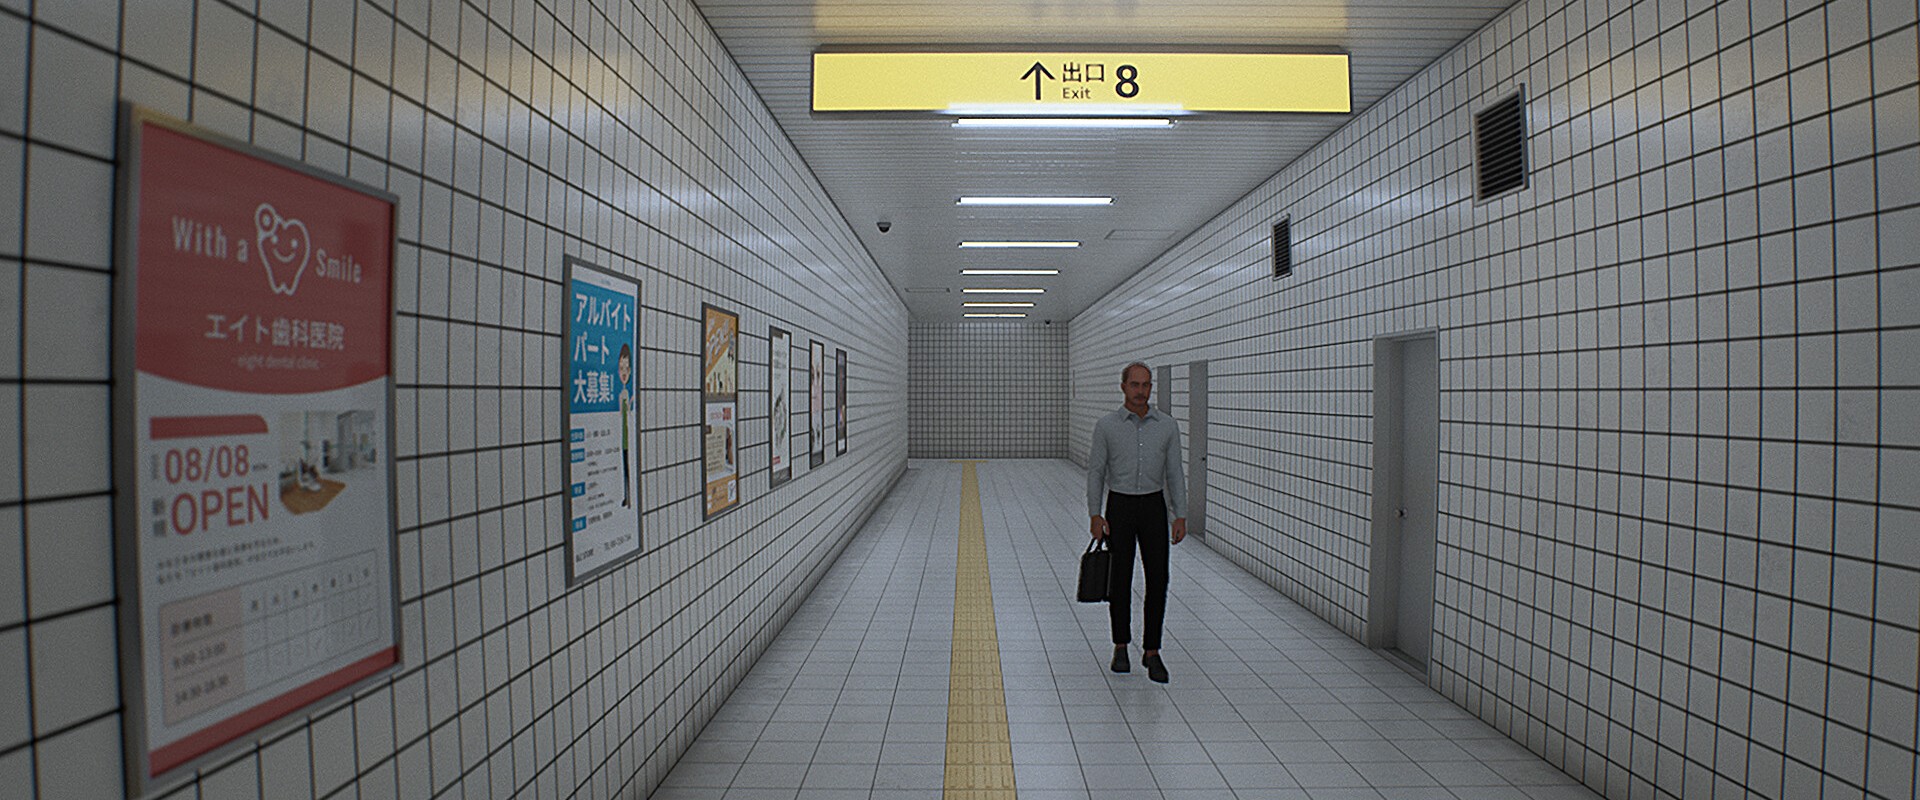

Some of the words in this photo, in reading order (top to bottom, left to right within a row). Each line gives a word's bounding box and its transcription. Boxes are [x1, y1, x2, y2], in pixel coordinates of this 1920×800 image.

[1062, 62, 1105, 82] 出口
[1115, 65, 1140, 97] 8
[1062, 86, 1091, 99] Exit
[171, 216, 227, 259] With
[237, 238, 248, 263] a
[315, 248, 362, 284] Smile
[575, 293, 631, 332] アルバイト
[204, 314, 345, 350] エイト歯科医院
[574, 331, 610, 365] パート
[165, 444, 249, 485] 08/08
[171, 483, 269, 536] OPEN
